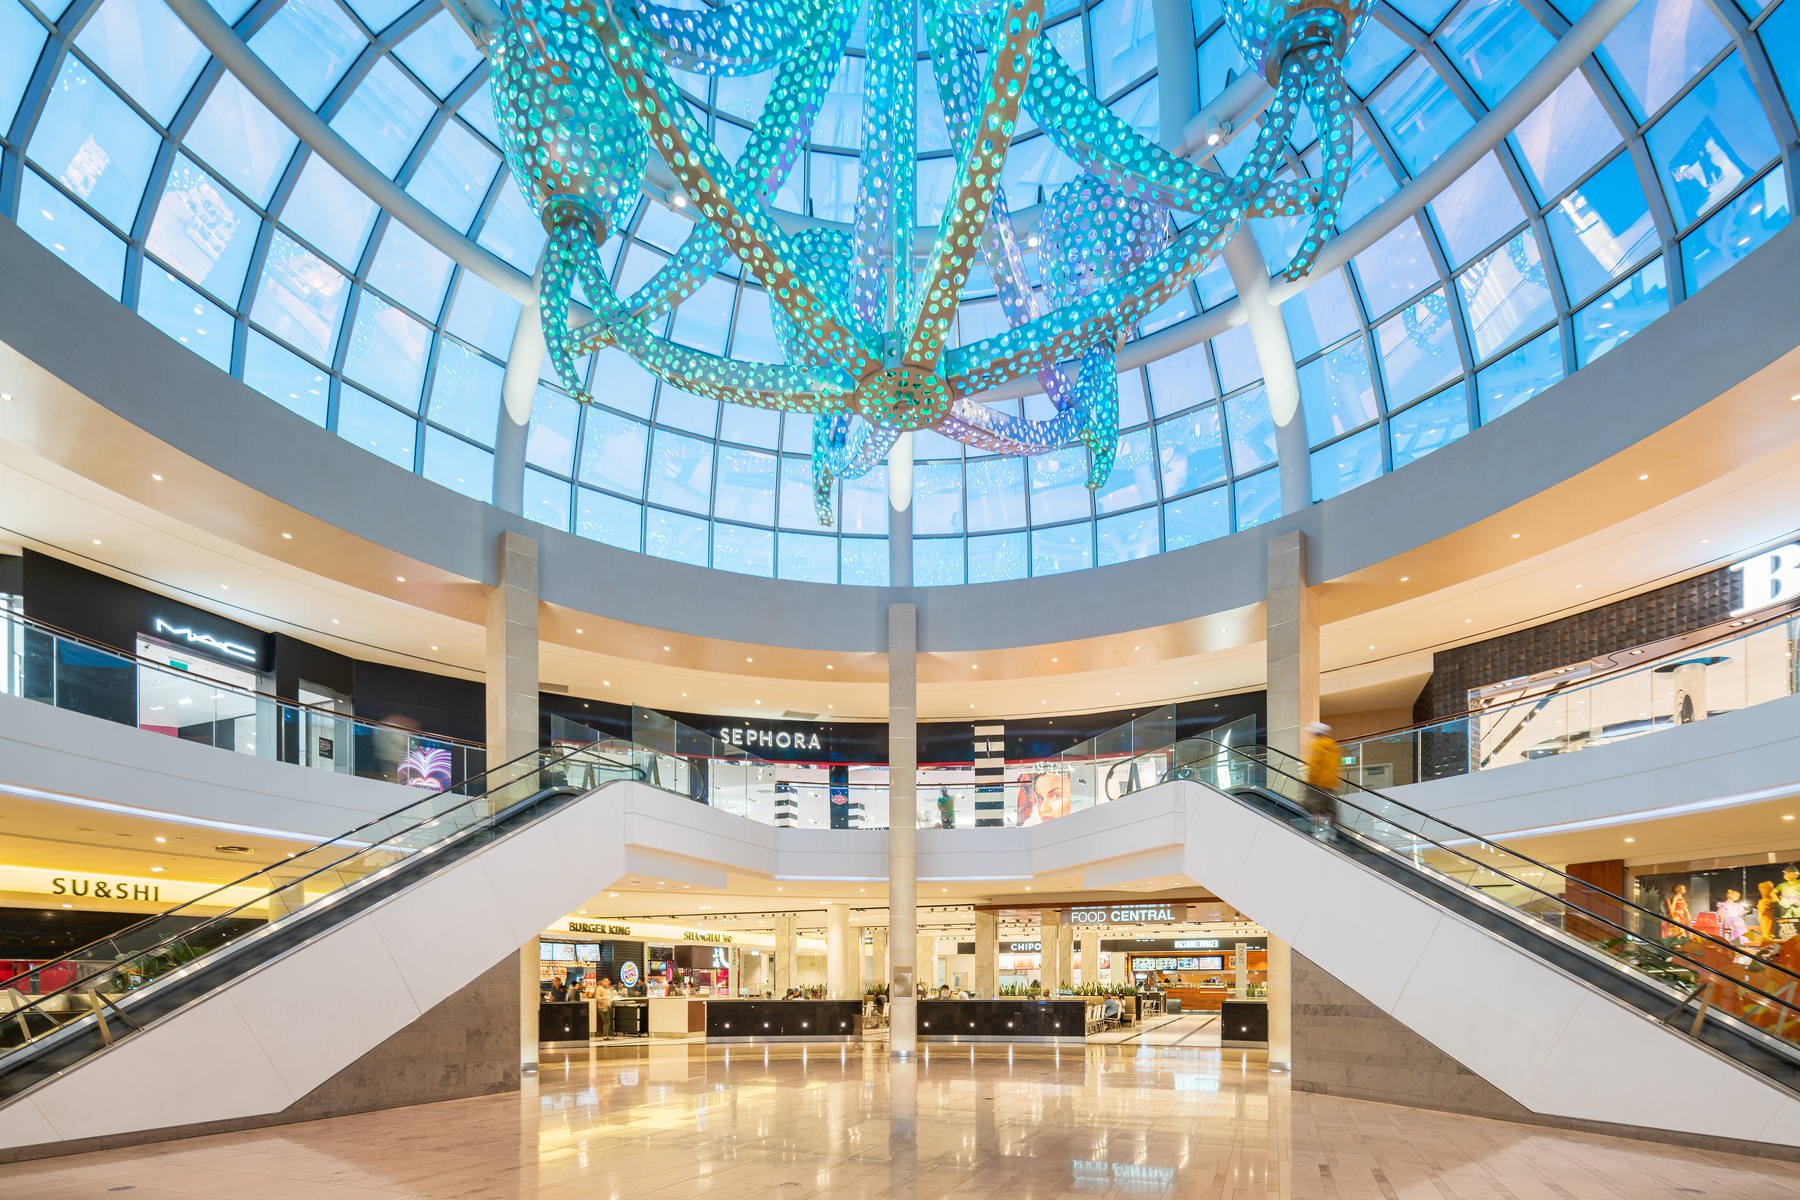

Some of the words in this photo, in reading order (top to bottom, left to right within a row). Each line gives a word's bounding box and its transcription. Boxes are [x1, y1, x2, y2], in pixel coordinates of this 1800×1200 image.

[720, 727, 821, 750] SEPHORA
[52, 877, 160, 902] SU&SHI
[1071, 910, 1107, 923] FOOD
[1110, 908, 1176, 922] CENTRAL
[568, 921, 606, 934] BURGER
[607, 925, 631, 936] KING
[683, 931, 721, 942] SHANGHAI
[722, 935, 733, 943] 360
